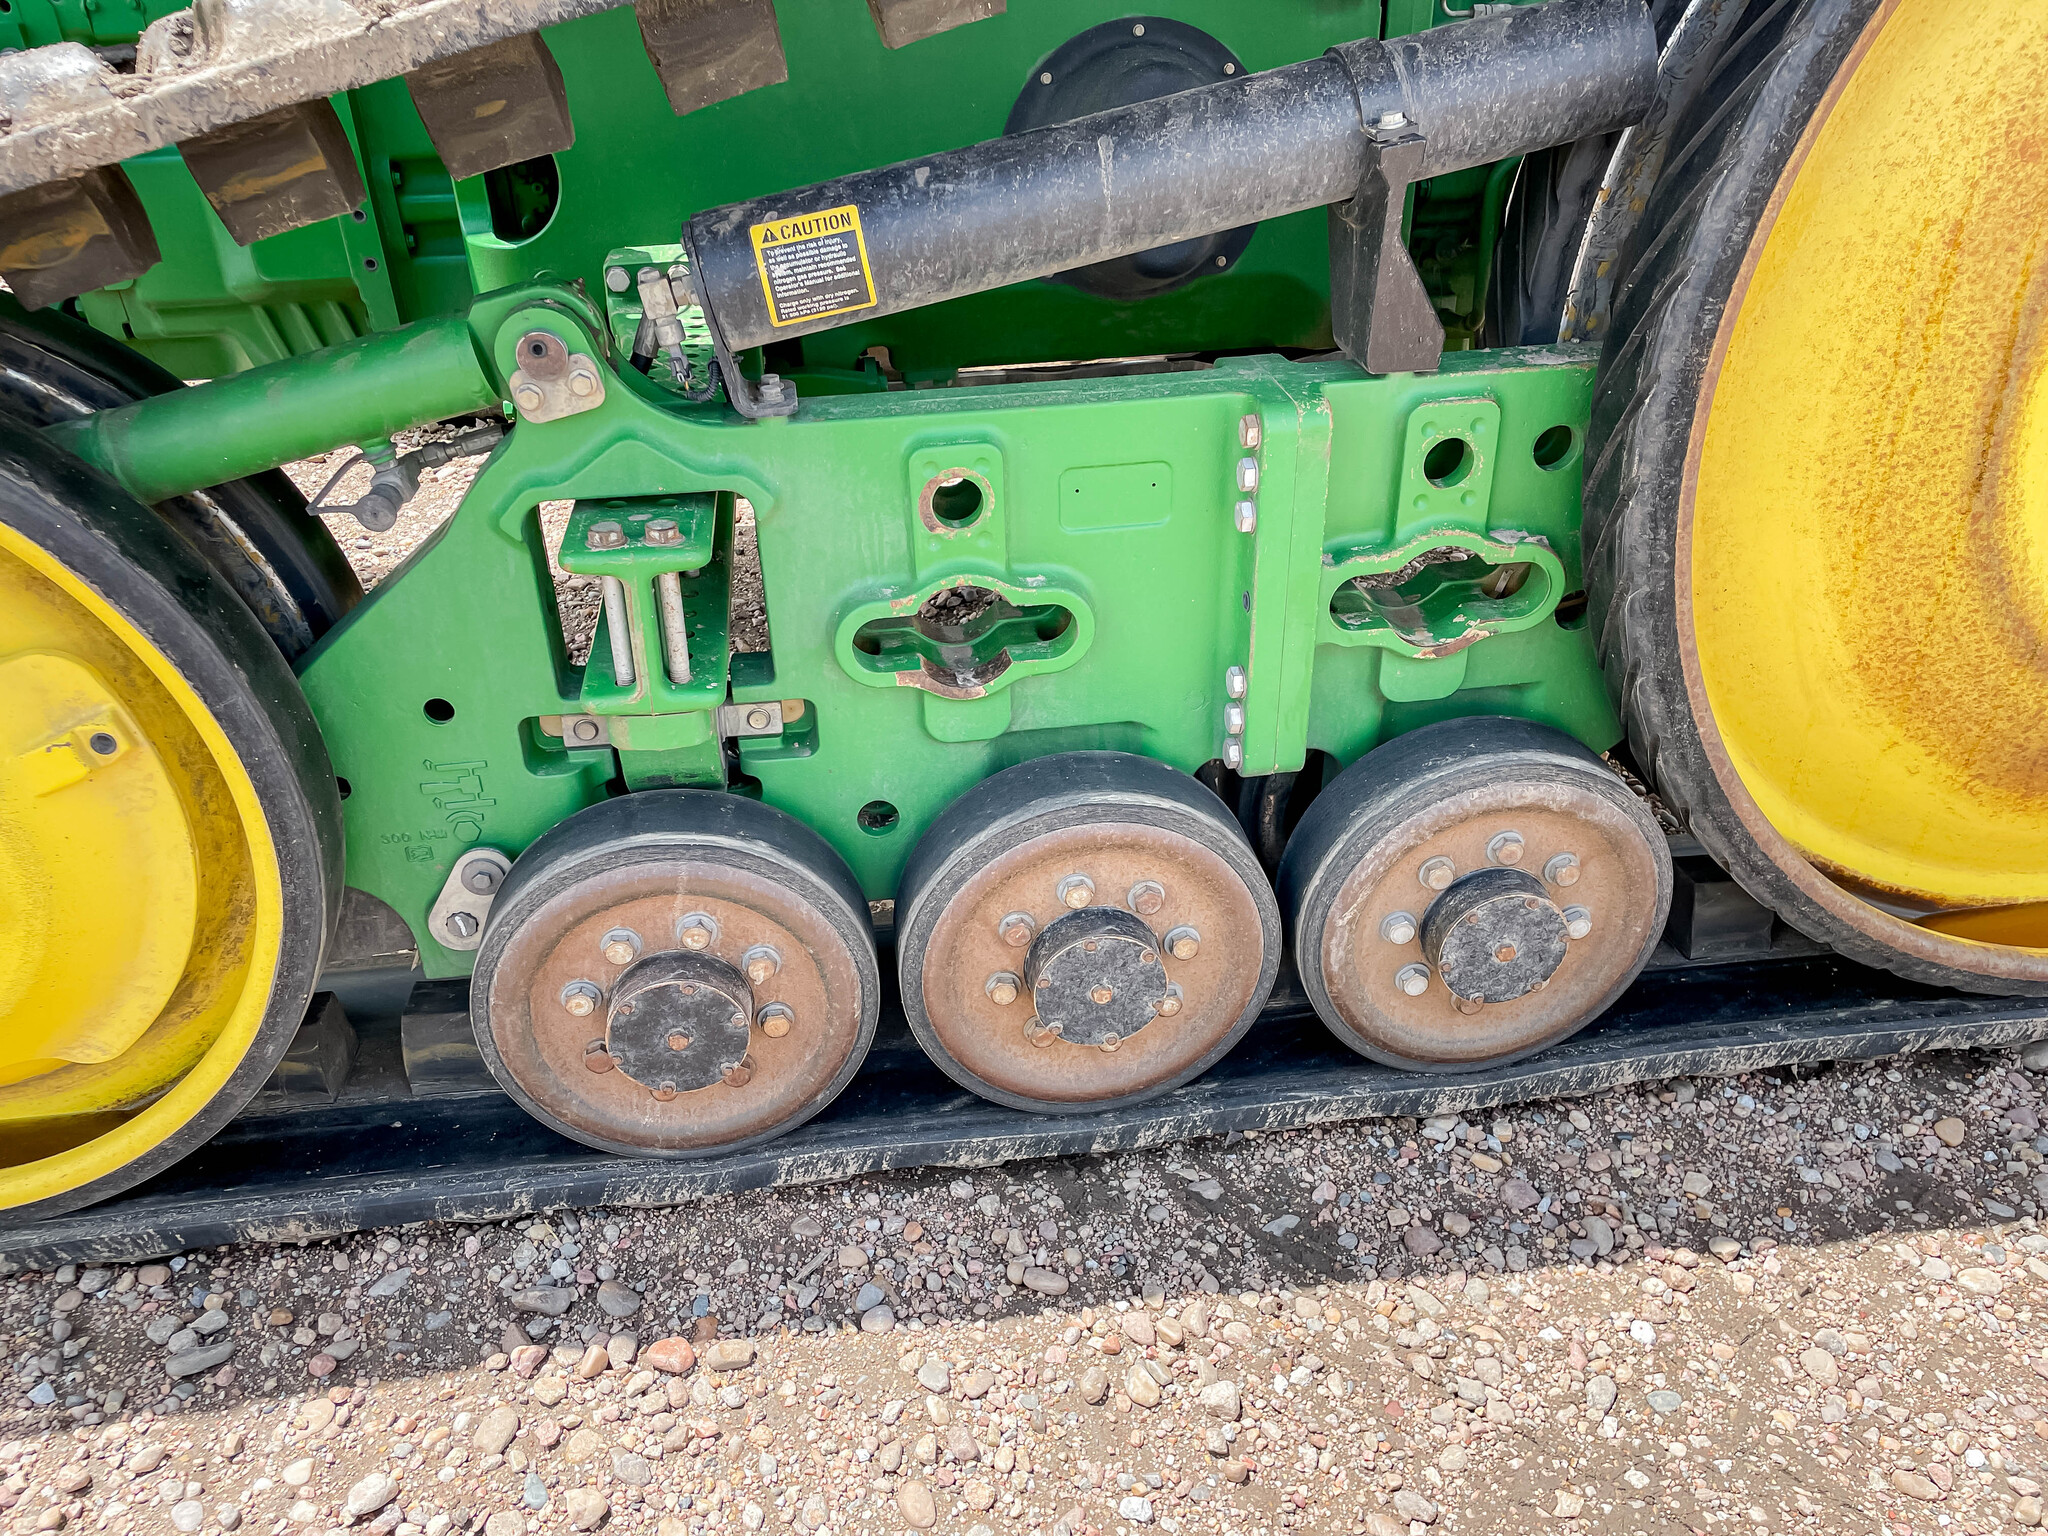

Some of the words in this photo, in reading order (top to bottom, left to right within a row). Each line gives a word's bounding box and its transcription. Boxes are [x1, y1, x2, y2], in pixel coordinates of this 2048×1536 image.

[779, 211, 851, 239] CAUTION
[774, 245, 795, 256] prevent
[805, 240, 817, 248] risk
[795, 248, 819, 259] possible
[819, 243, 841, 254] damage
[793, 263, 817, 273] maintain
[817, 255, 856, 268] recommended
[773, 275, 796, 286] nitrogen
[796, 273, 807, 281] gas
[803, 276, 824, 286] Manual
[833, 268, 860, 280] additional
[778, 299, 799, 309] Charge
[798, 296, 811, 305] only
[811, 294, 824, 302] with
[834, 286, 859, 298] nitrogen.
[780, 306, 796, 314] Rated
[796, 301, 819, 311] working
[819, 296, 843, 306] pressure
